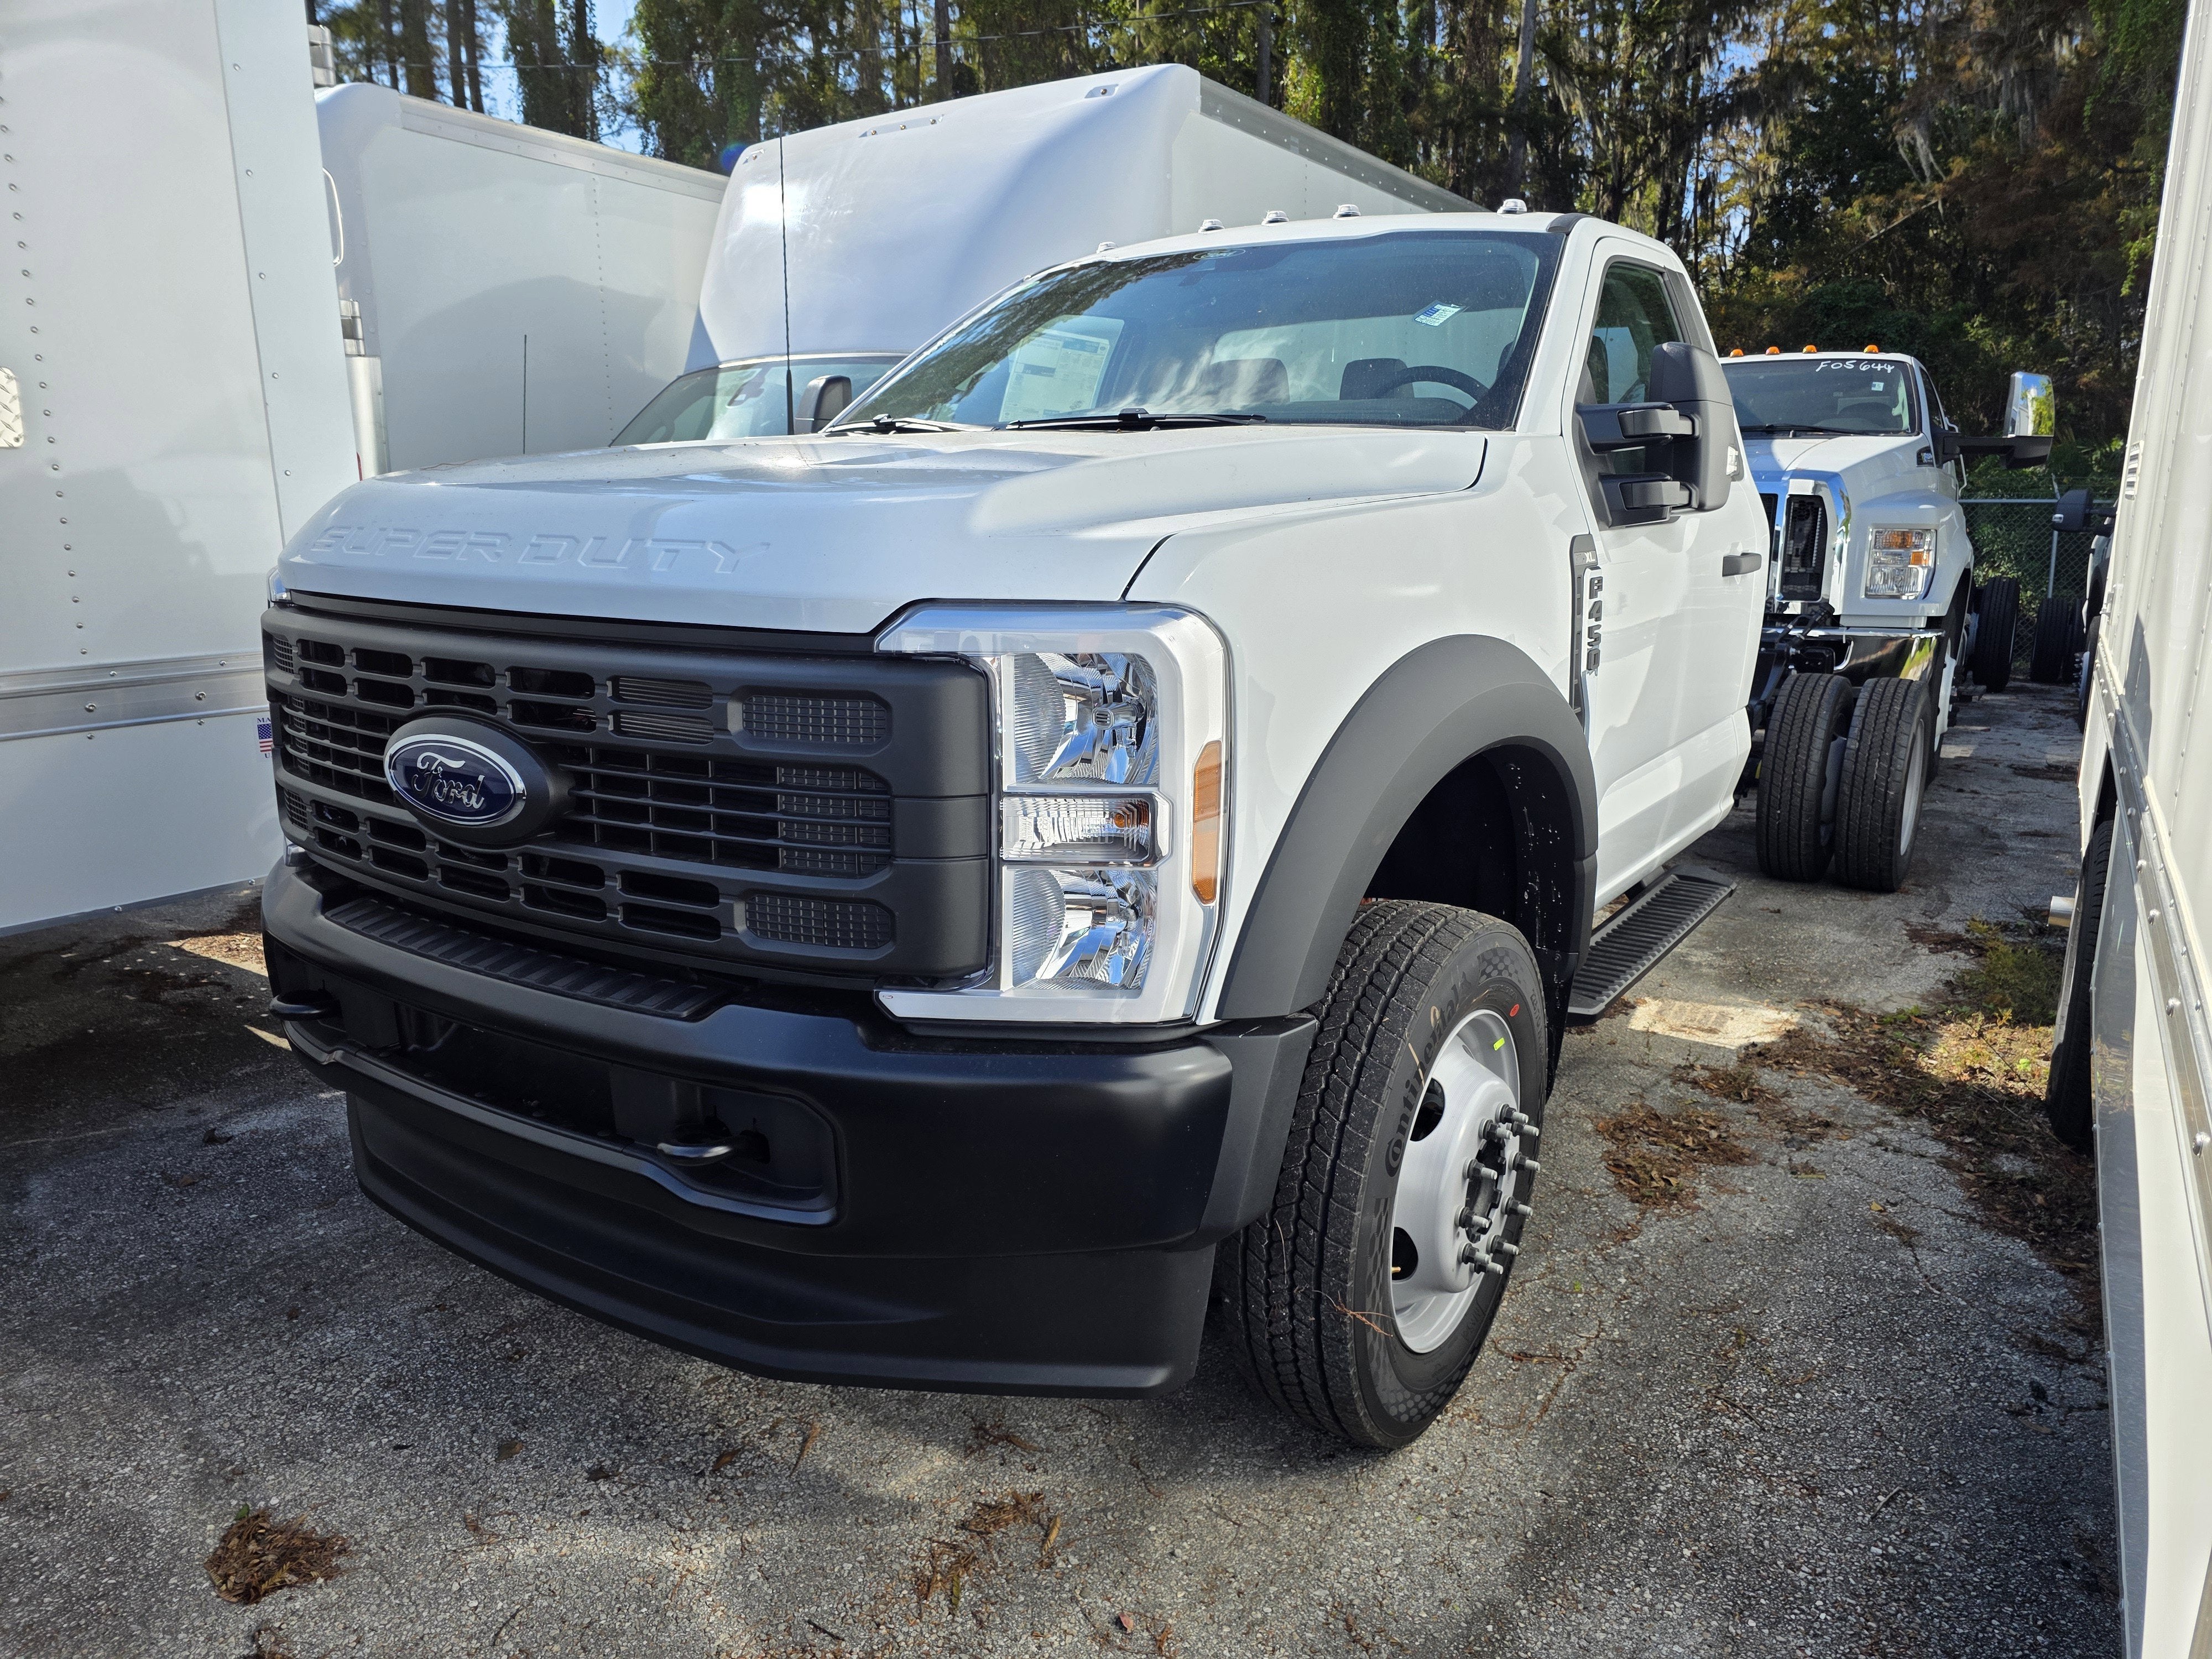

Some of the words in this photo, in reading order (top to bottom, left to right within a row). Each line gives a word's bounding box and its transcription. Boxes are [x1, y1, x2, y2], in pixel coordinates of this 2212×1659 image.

[310, 525, 513, 563] SUPER
[517, 533, 771, 574] DUTY
[1584, 551, 1596, 564] XL
[1586, 576, 1603, 671] F450
[411, 751, 486, 809] Ford
[1385, 983, 1459, 1178] Continental
